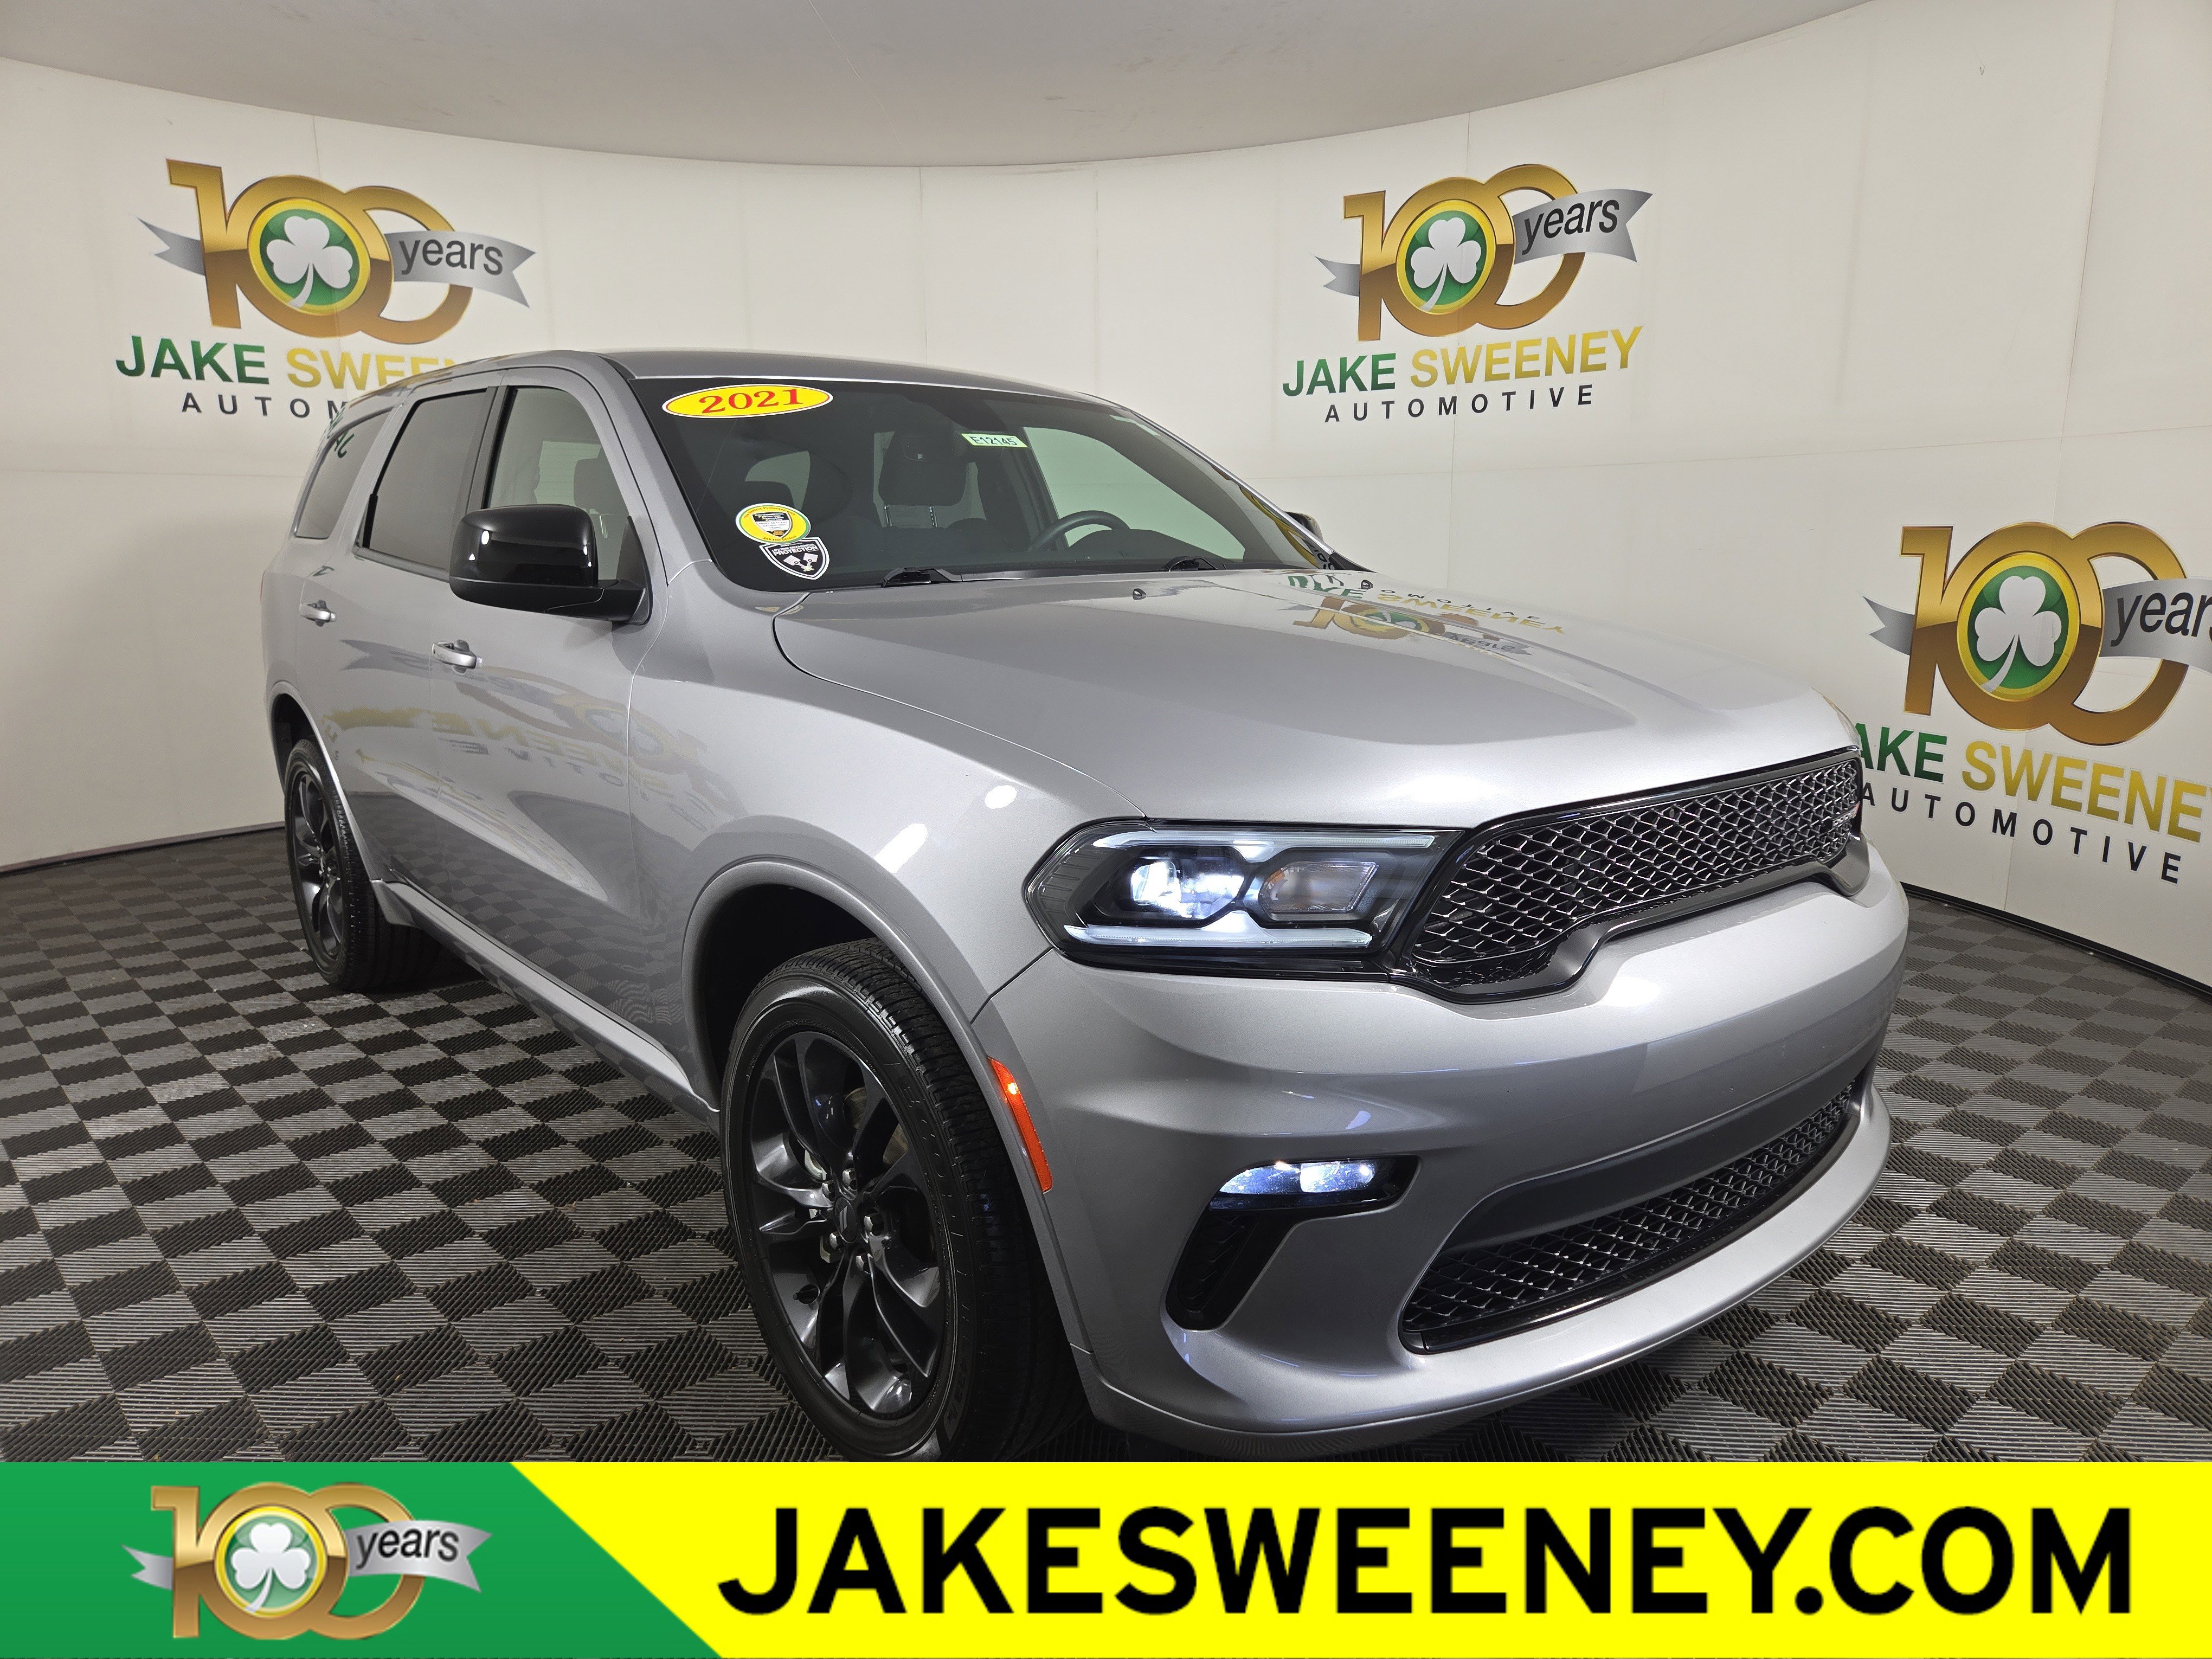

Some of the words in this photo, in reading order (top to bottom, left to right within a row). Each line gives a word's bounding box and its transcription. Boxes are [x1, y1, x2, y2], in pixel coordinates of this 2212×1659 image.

[1521, 199, 1619, 255] years
[400, 239, 504, 275] years
[115, 335, 270, 384] JAKE
[1283, 352, 1397, 397] JAKE
[1410, 326, 1643, 388] SWEENEY
[699, 389, 803, 414] 2021
[1324, 384, 1593, 423] AUTOMOTIVE
[969, 436, 1018, 446] E12145
[773, 545, 819, 556] PROTECTION
[2110, 590, 2212, 647] year
[1854, 723, 1948, 782] AKE
[1962, 740, 2212, 844] SWEENE
[1862, 782, 2181, 884] AUTOMOTIVE
